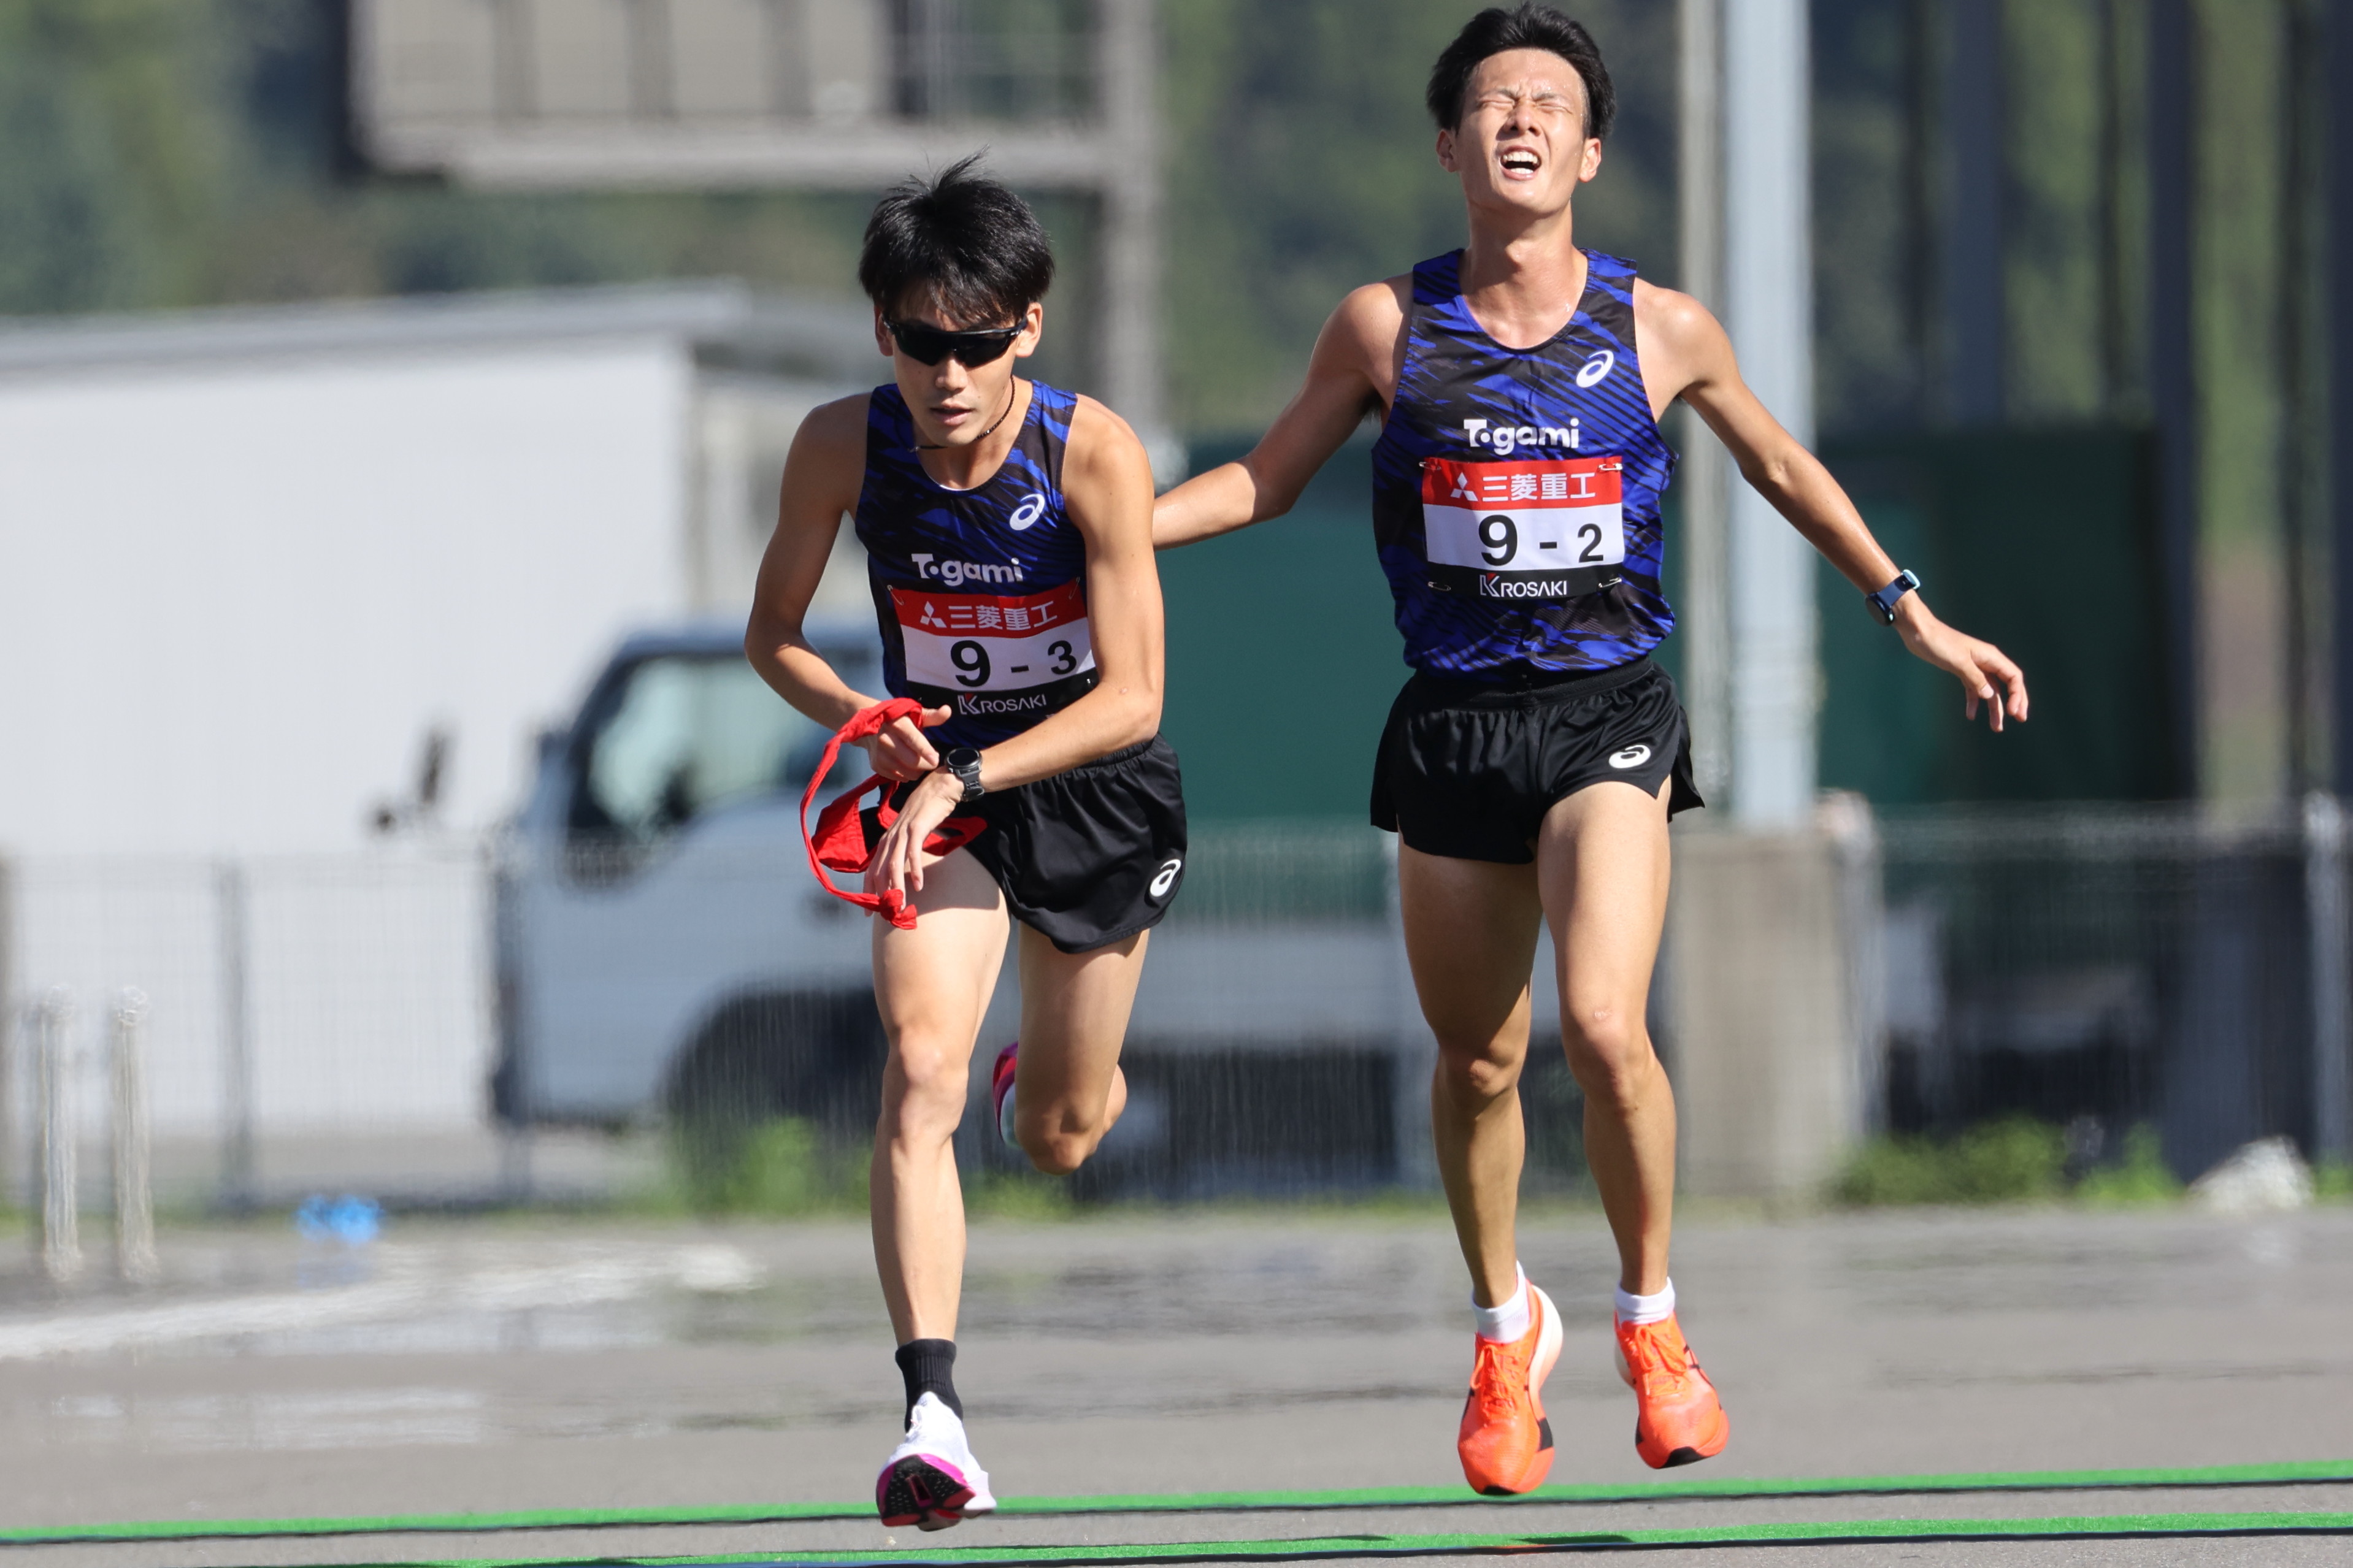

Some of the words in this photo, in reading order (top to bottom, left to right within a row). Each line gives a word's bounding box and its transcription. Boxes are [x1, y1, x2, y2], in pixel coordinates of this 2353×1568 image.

[1481, 472, 1596, 502] 三菱重工
[1479, 573, 1567, 597] KROSAKI
[948, 601, 1058, 631] 三菱重工
[957, 693, 1046, 715] KROSAKI
